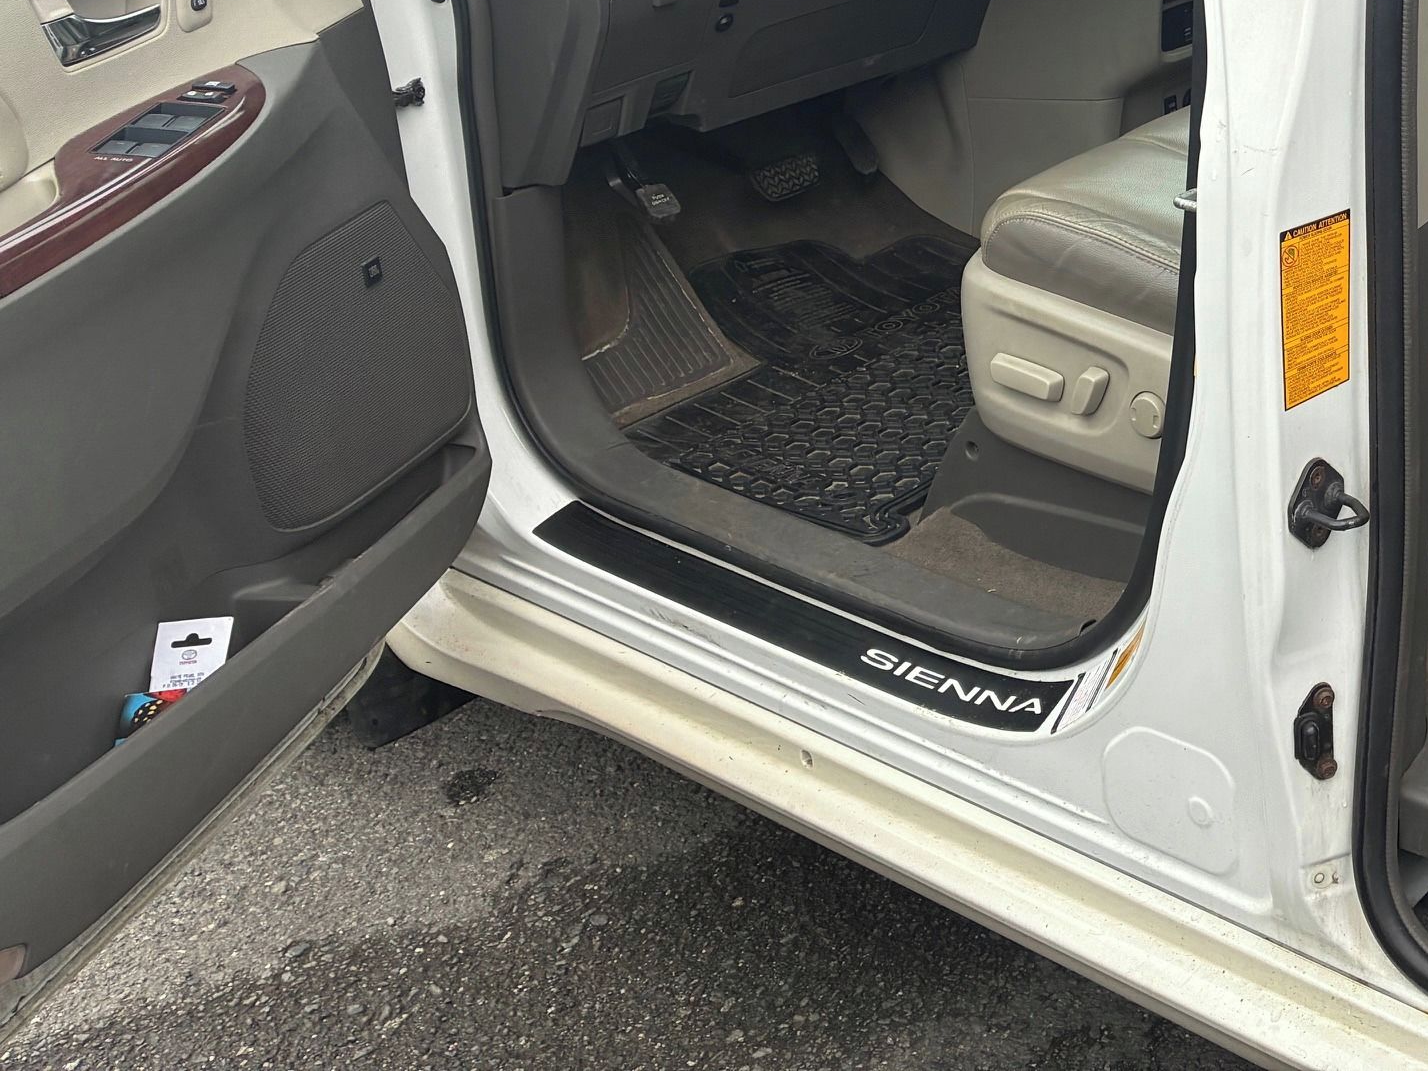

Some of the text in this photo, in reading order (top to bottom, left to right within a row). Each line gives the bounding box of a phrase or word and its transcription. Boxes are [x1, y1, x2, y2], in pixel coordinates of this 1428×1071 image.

[1292, 213, 1347, 237] CAUTION ATTENTION
[860, 648, 1042, 715] SIENNA
